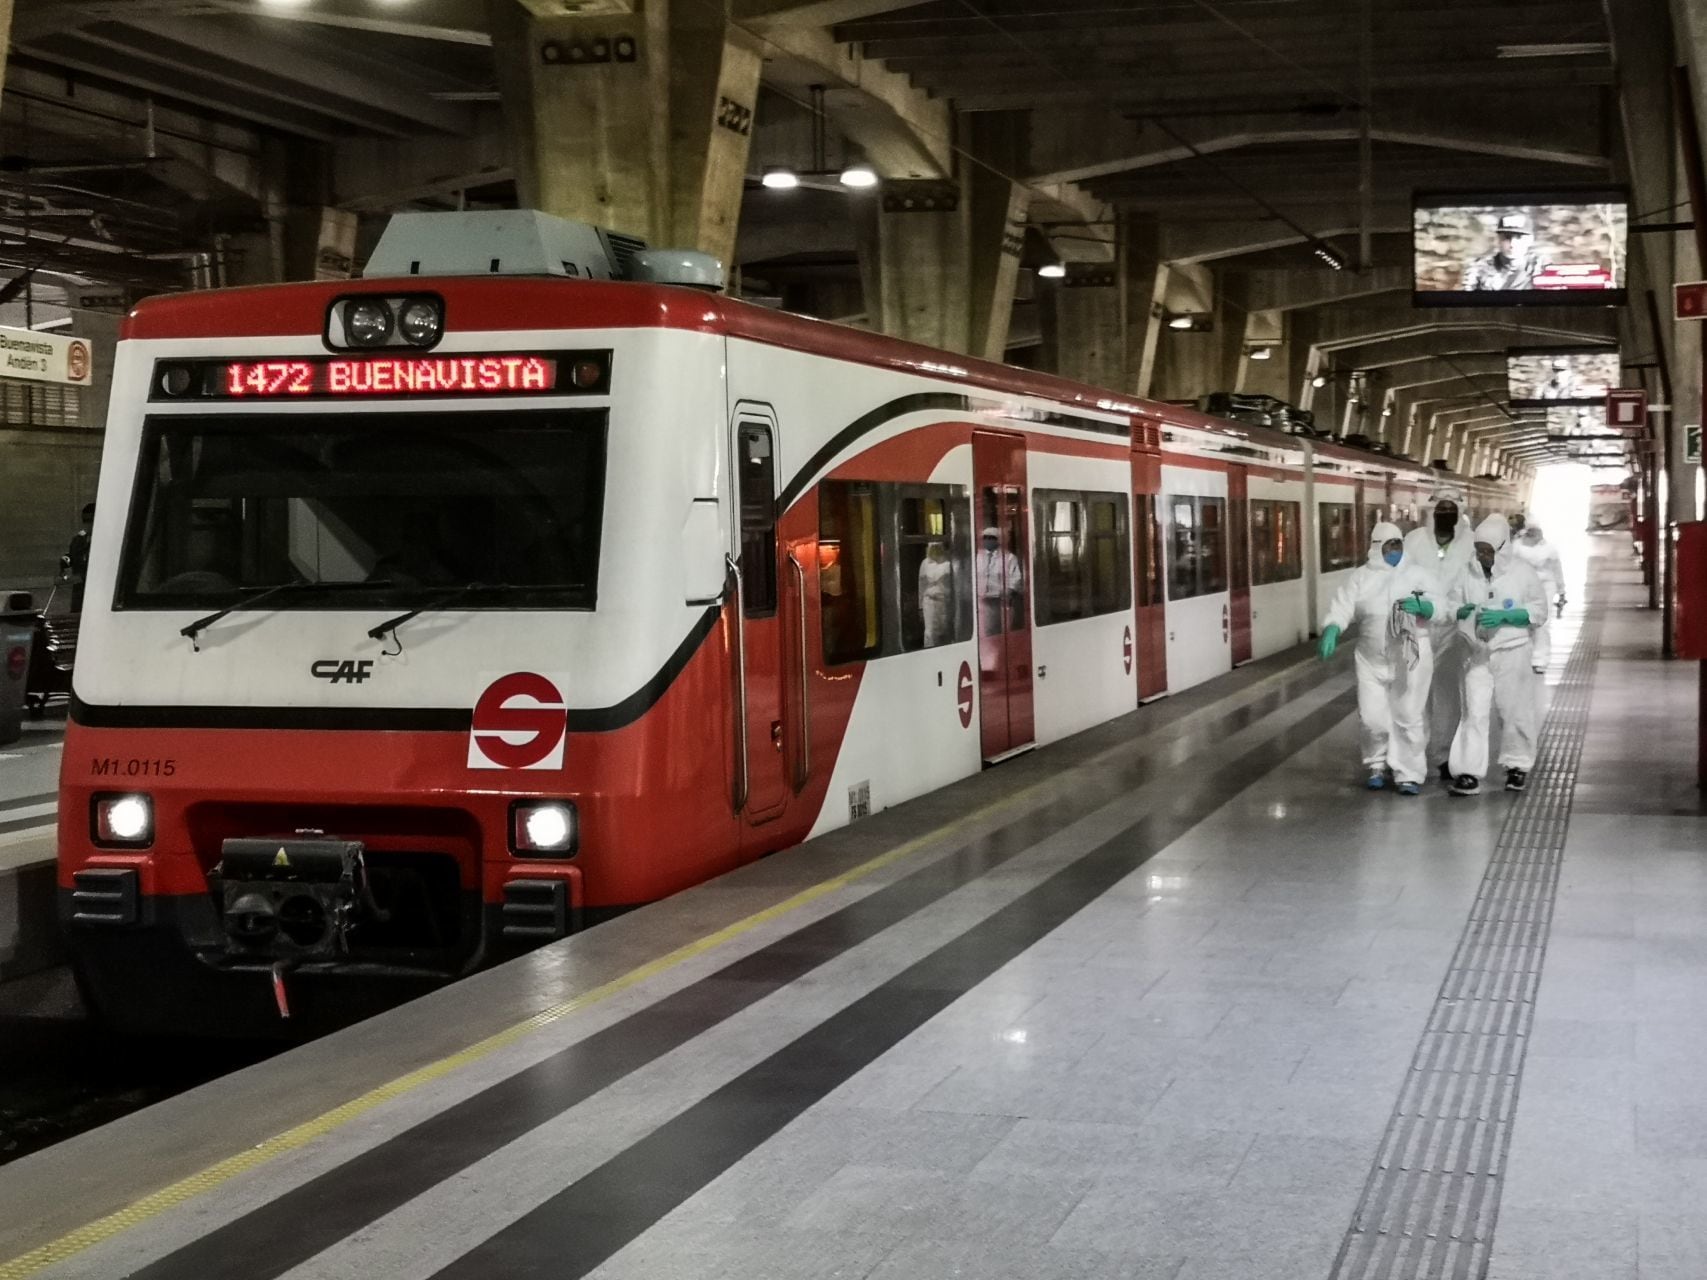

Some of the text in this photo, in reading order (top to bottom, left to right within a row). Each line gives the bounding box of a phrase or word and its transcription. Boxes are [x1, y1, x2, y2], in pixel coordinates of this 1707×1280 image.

[229, 358, 545, 393] 1472 BUENAVISTA
[311, 660, 374, 683] CAF
[91, 758, 176, 776] M1.0115
